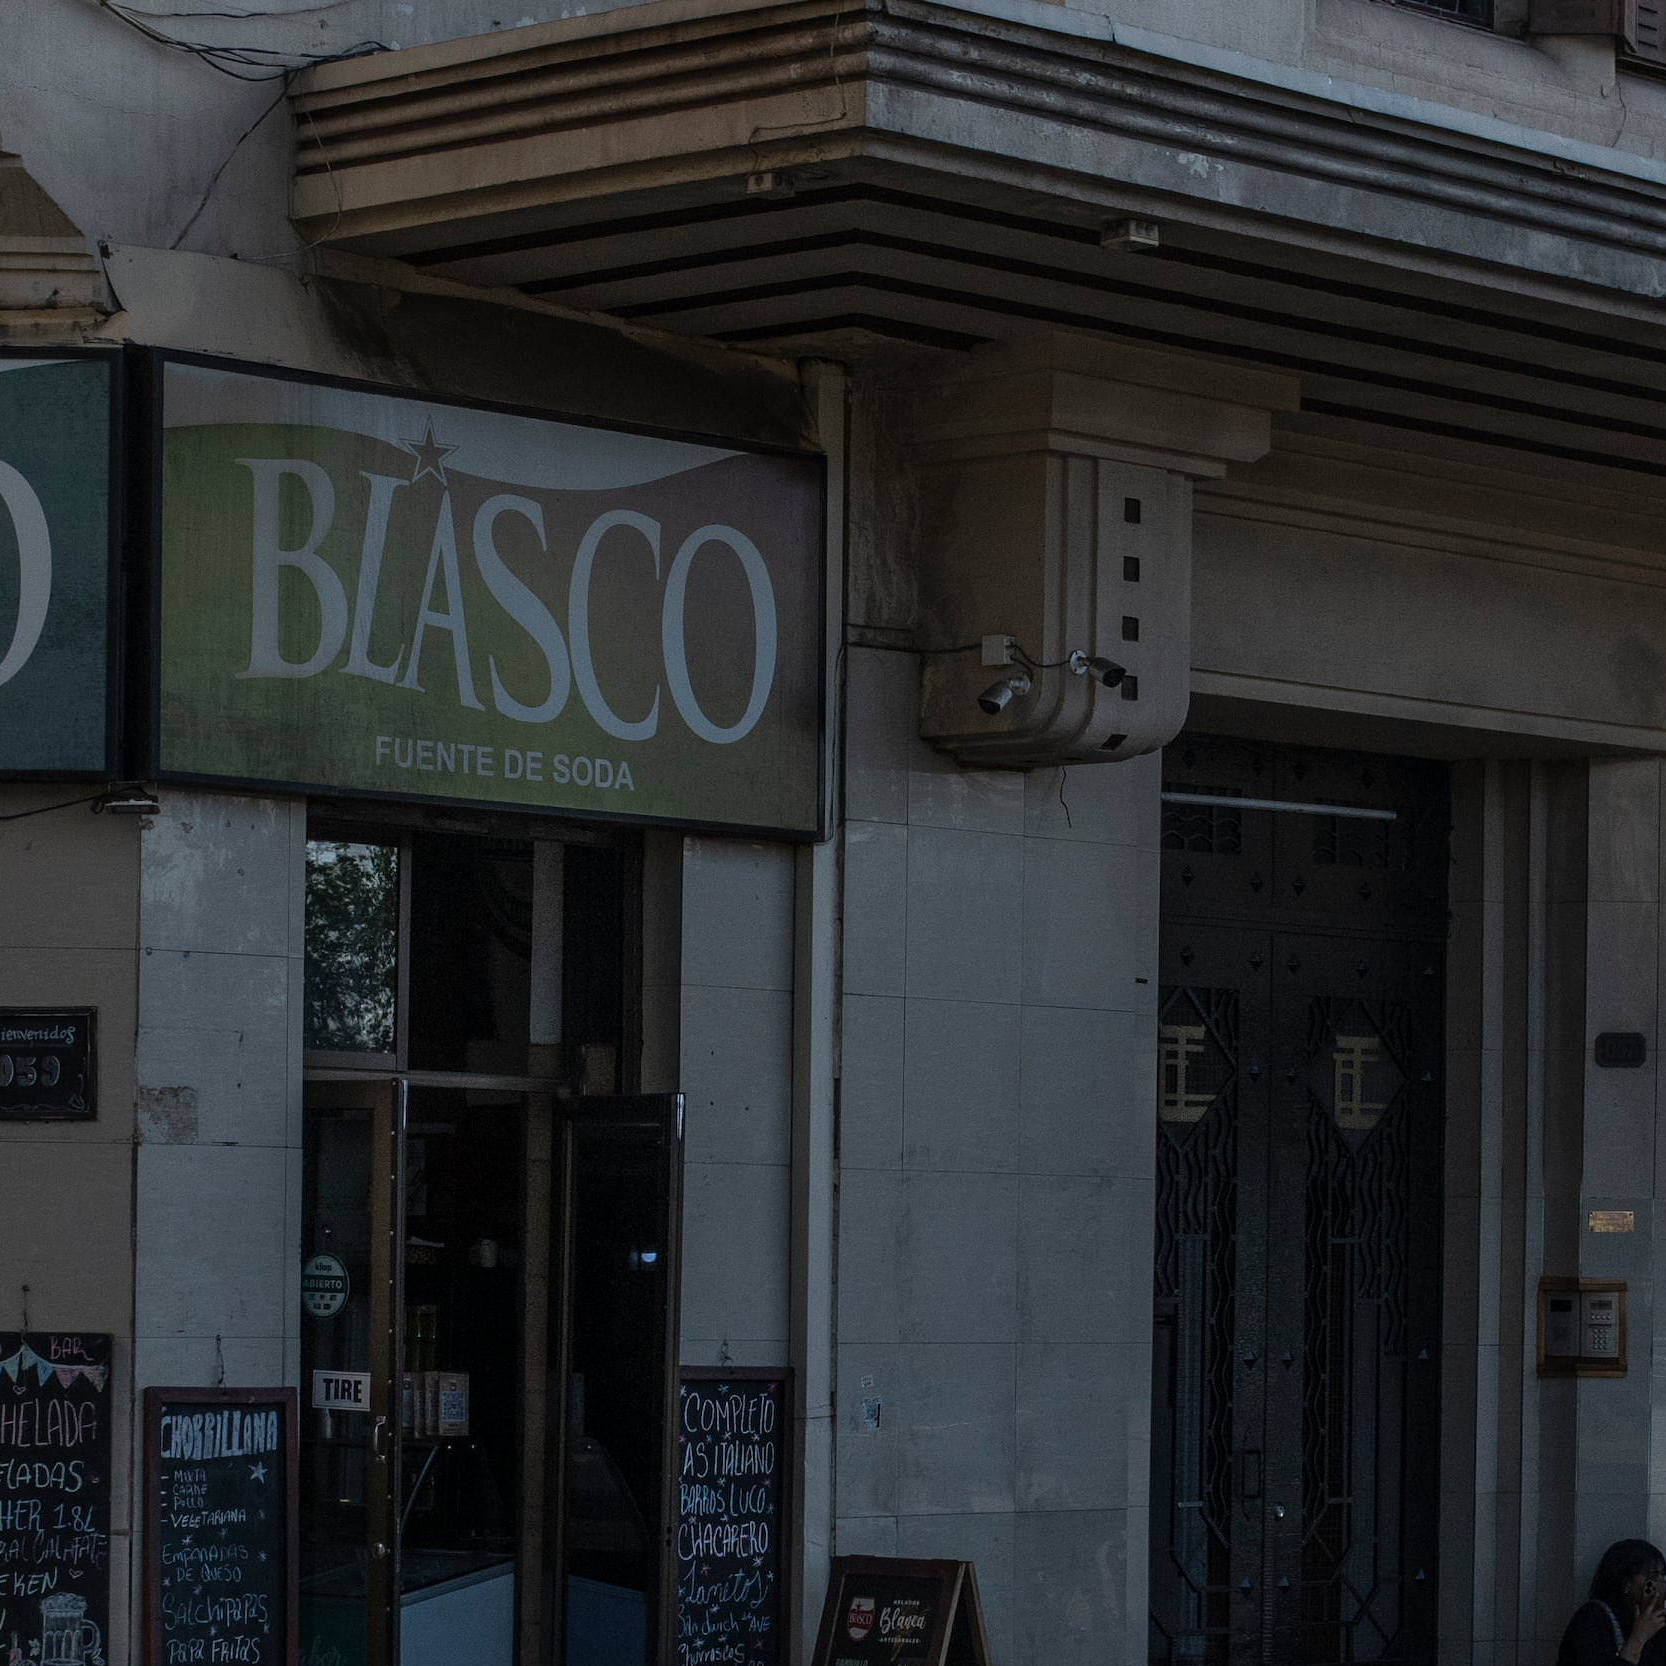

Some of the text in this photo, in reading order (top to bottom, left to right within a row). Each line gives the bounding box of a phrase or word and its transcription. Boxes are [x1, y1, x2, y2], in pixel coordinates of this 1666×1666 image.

[234, 458, 777, 744] BLASCO
[375, 735, 634, 791] FUENTE DE SODA
[303, 1279, 343, 1290] ABIERTO
[50, 1337, 93, 1361] BAR
[323, 1378, 362, 1404] TIRE
[684, 1392, 775, 1434] COMPLETO
[161, 1410, 278, 1460] CHORRILLANA
[683, 1440, 775, 1478] AS ITALIANO
[174, 1468, 207, 1483] MIXTA
[679, 1482, 766, 1517] BARROS LUCO
[170, 1509, 247, 1528] VEGETARIANA
[678, 1521, 769, 1560] CHACARERO
[176, 1564, 242, 1583] DE QUESO
[749, 1616, 771, 1633] AVE
